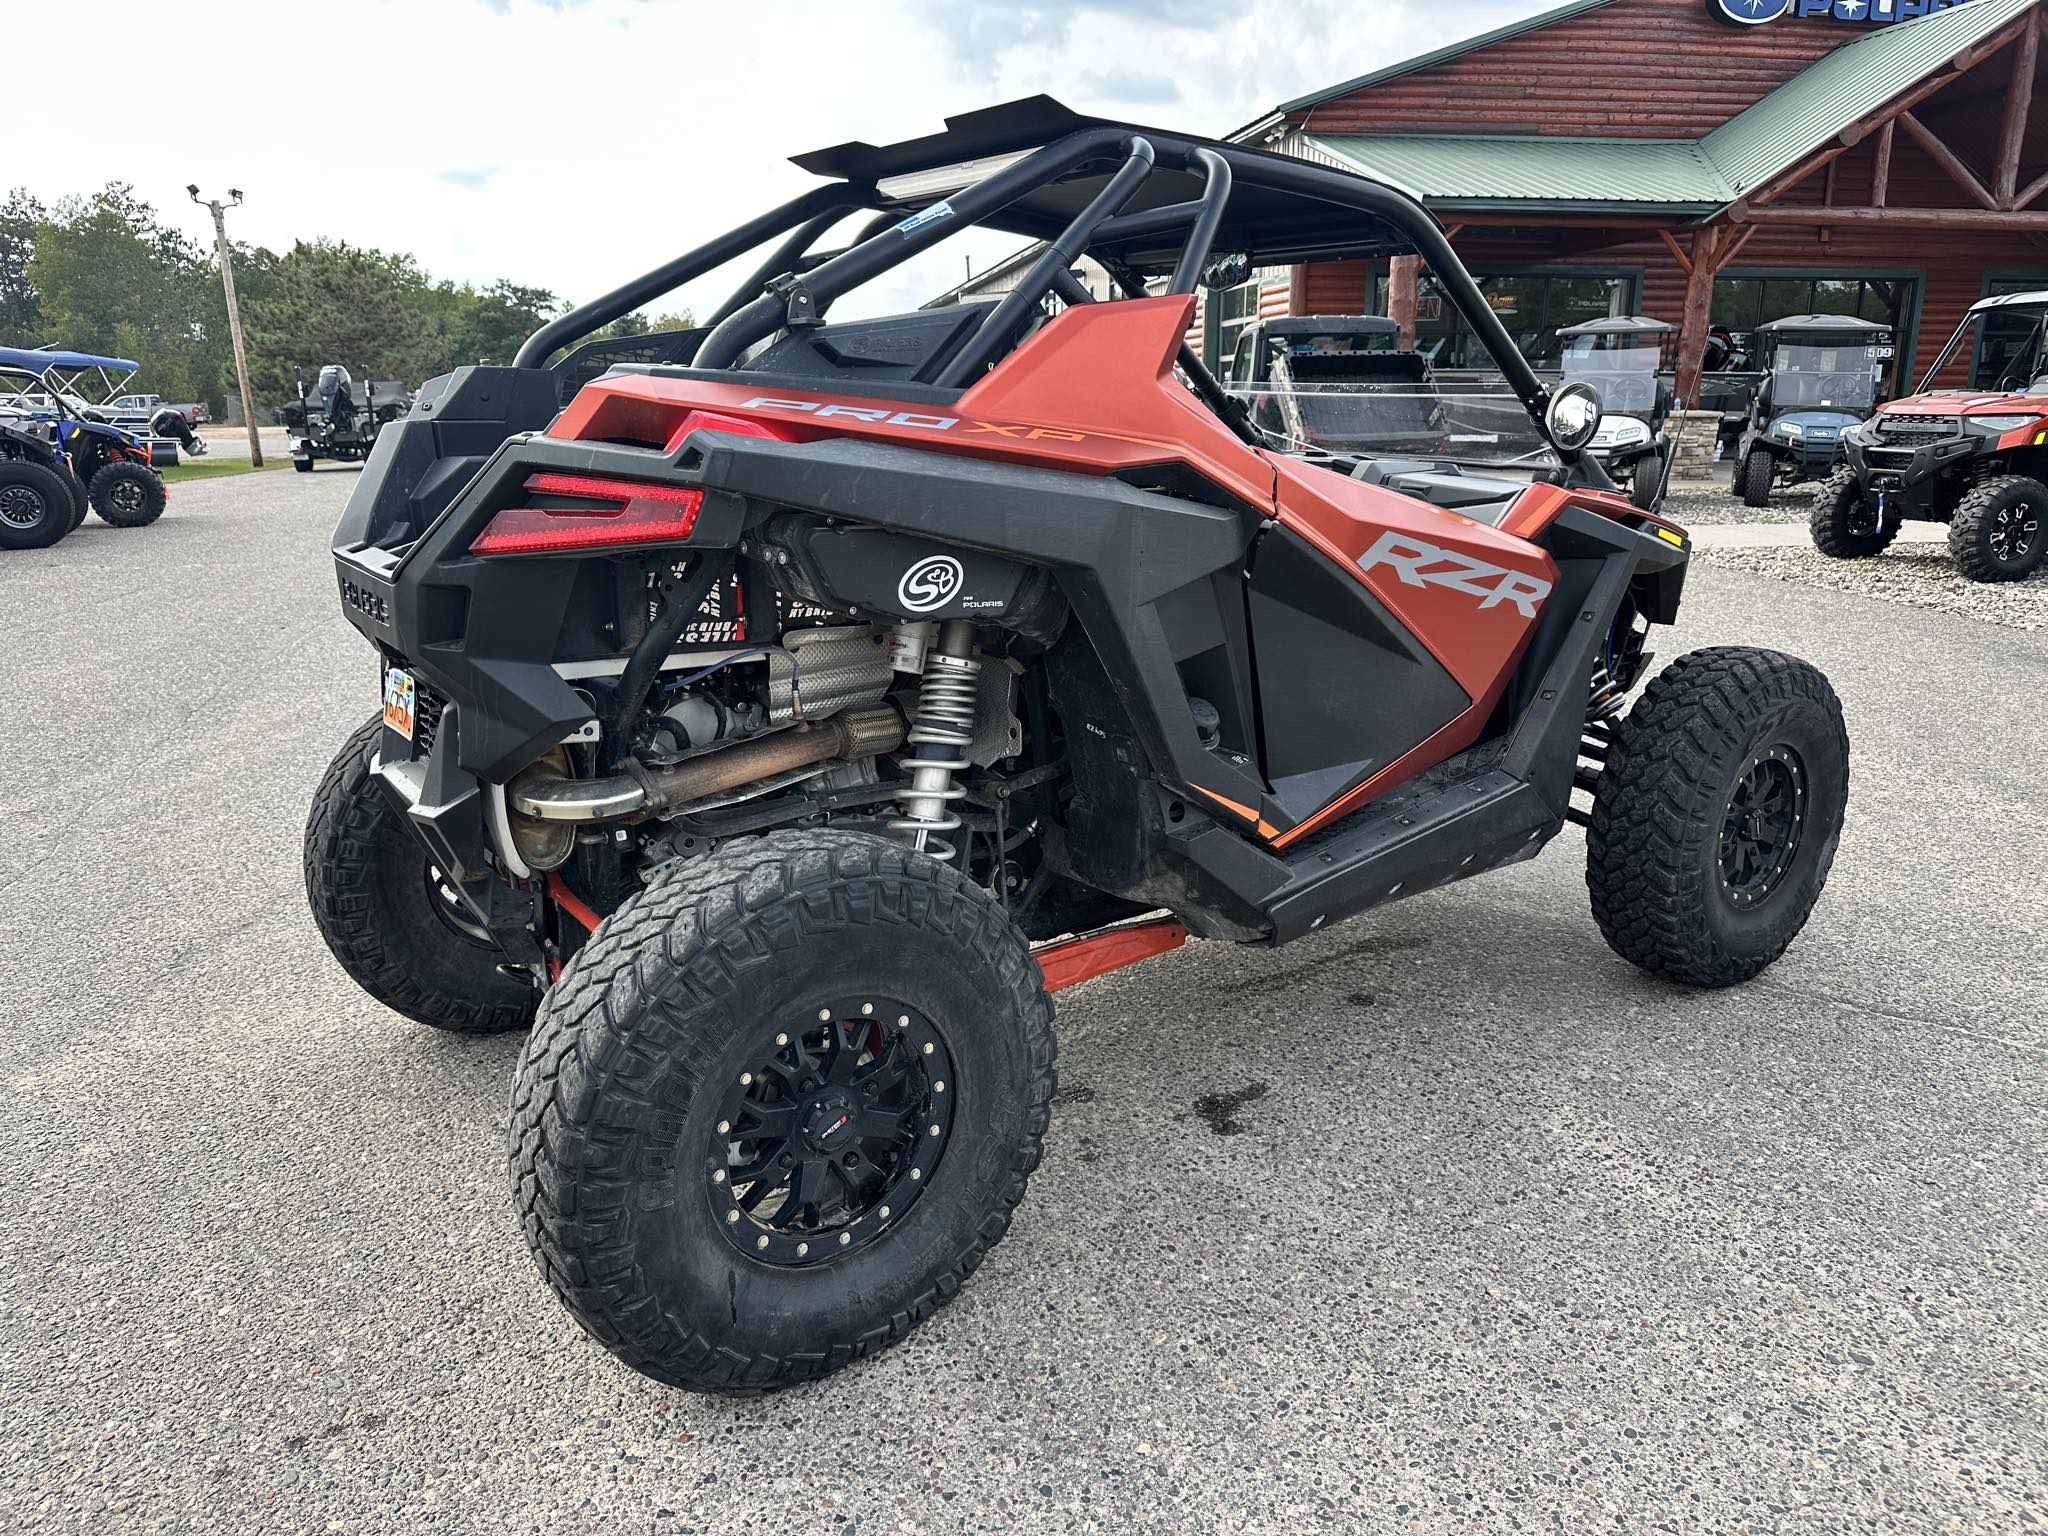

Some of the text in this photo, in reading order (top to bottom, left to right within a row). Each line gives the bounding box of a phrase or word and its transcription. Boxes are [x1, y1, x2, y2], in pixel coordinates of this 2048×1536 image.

[1416, 299, 1438, 318] EN
[1867, 347, 1892, 358] 509
[738, 397, 1086, 442] PRO XP
[1356, 530, 1553, 619] RZR
[342, 577, 390, 627] POLARIS
[963, 600, 1004, 609] POLARIS
